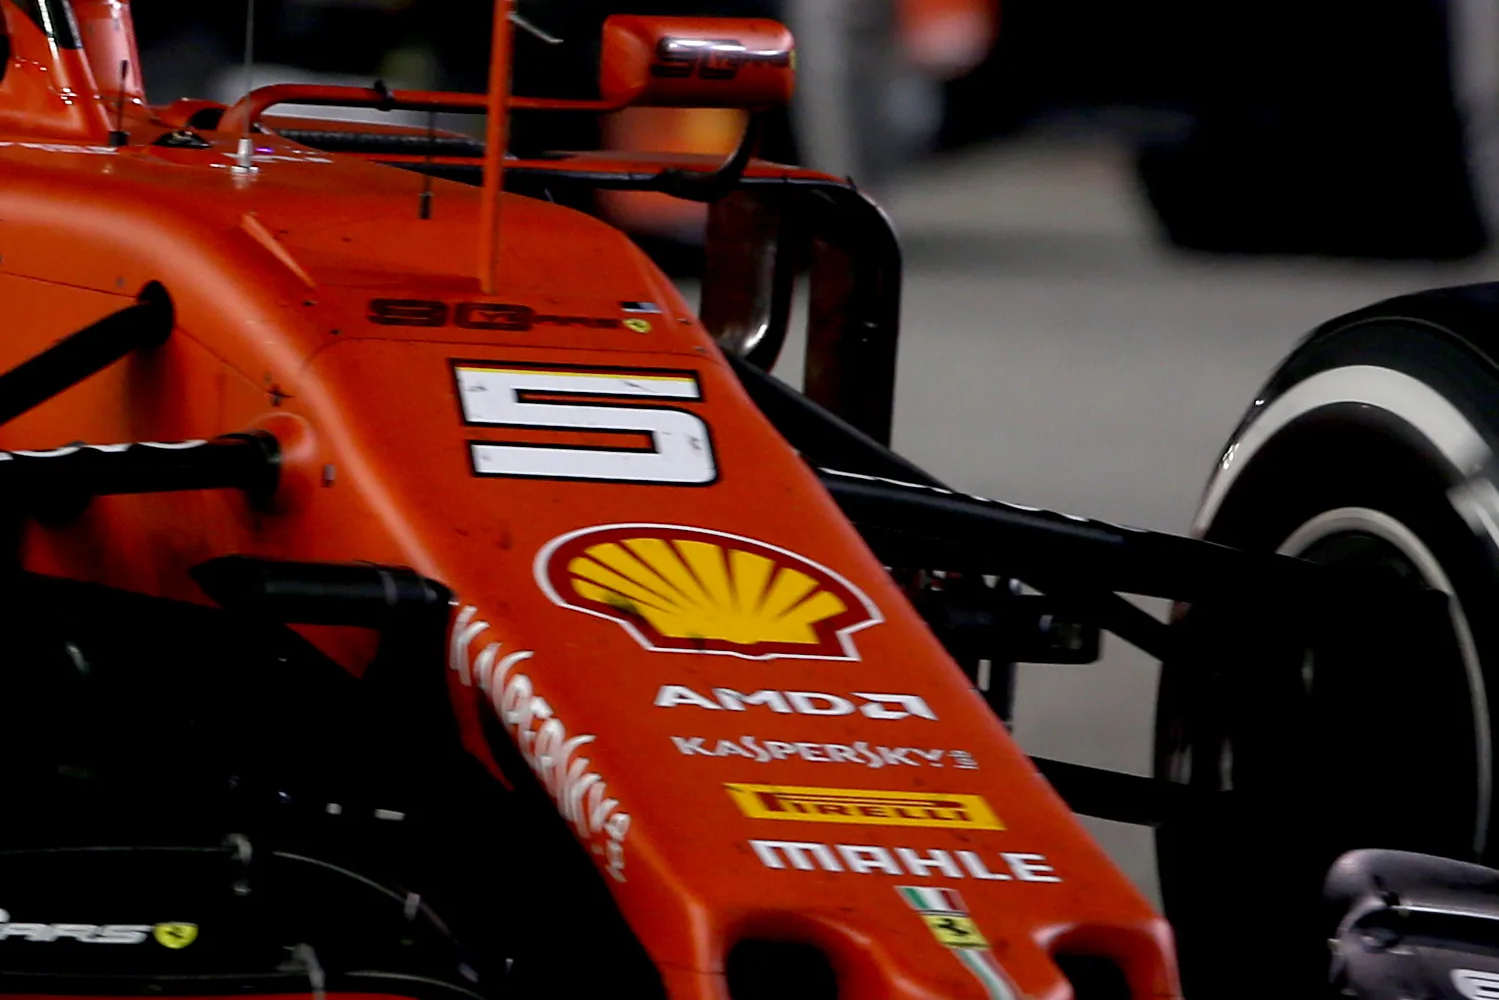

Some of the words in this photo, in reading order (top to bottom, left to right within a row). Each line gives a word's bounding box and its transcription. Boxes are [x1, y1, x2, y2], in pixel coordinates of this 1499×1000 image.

[450, 360, 719, 486] 5
[655, 685, 857, 716] AMD
[669, 735, 944, 769] KASPERSKY
[754, 790, 975, 823] PIRELLI
[748, 839, 1062, 883] MAHLE
